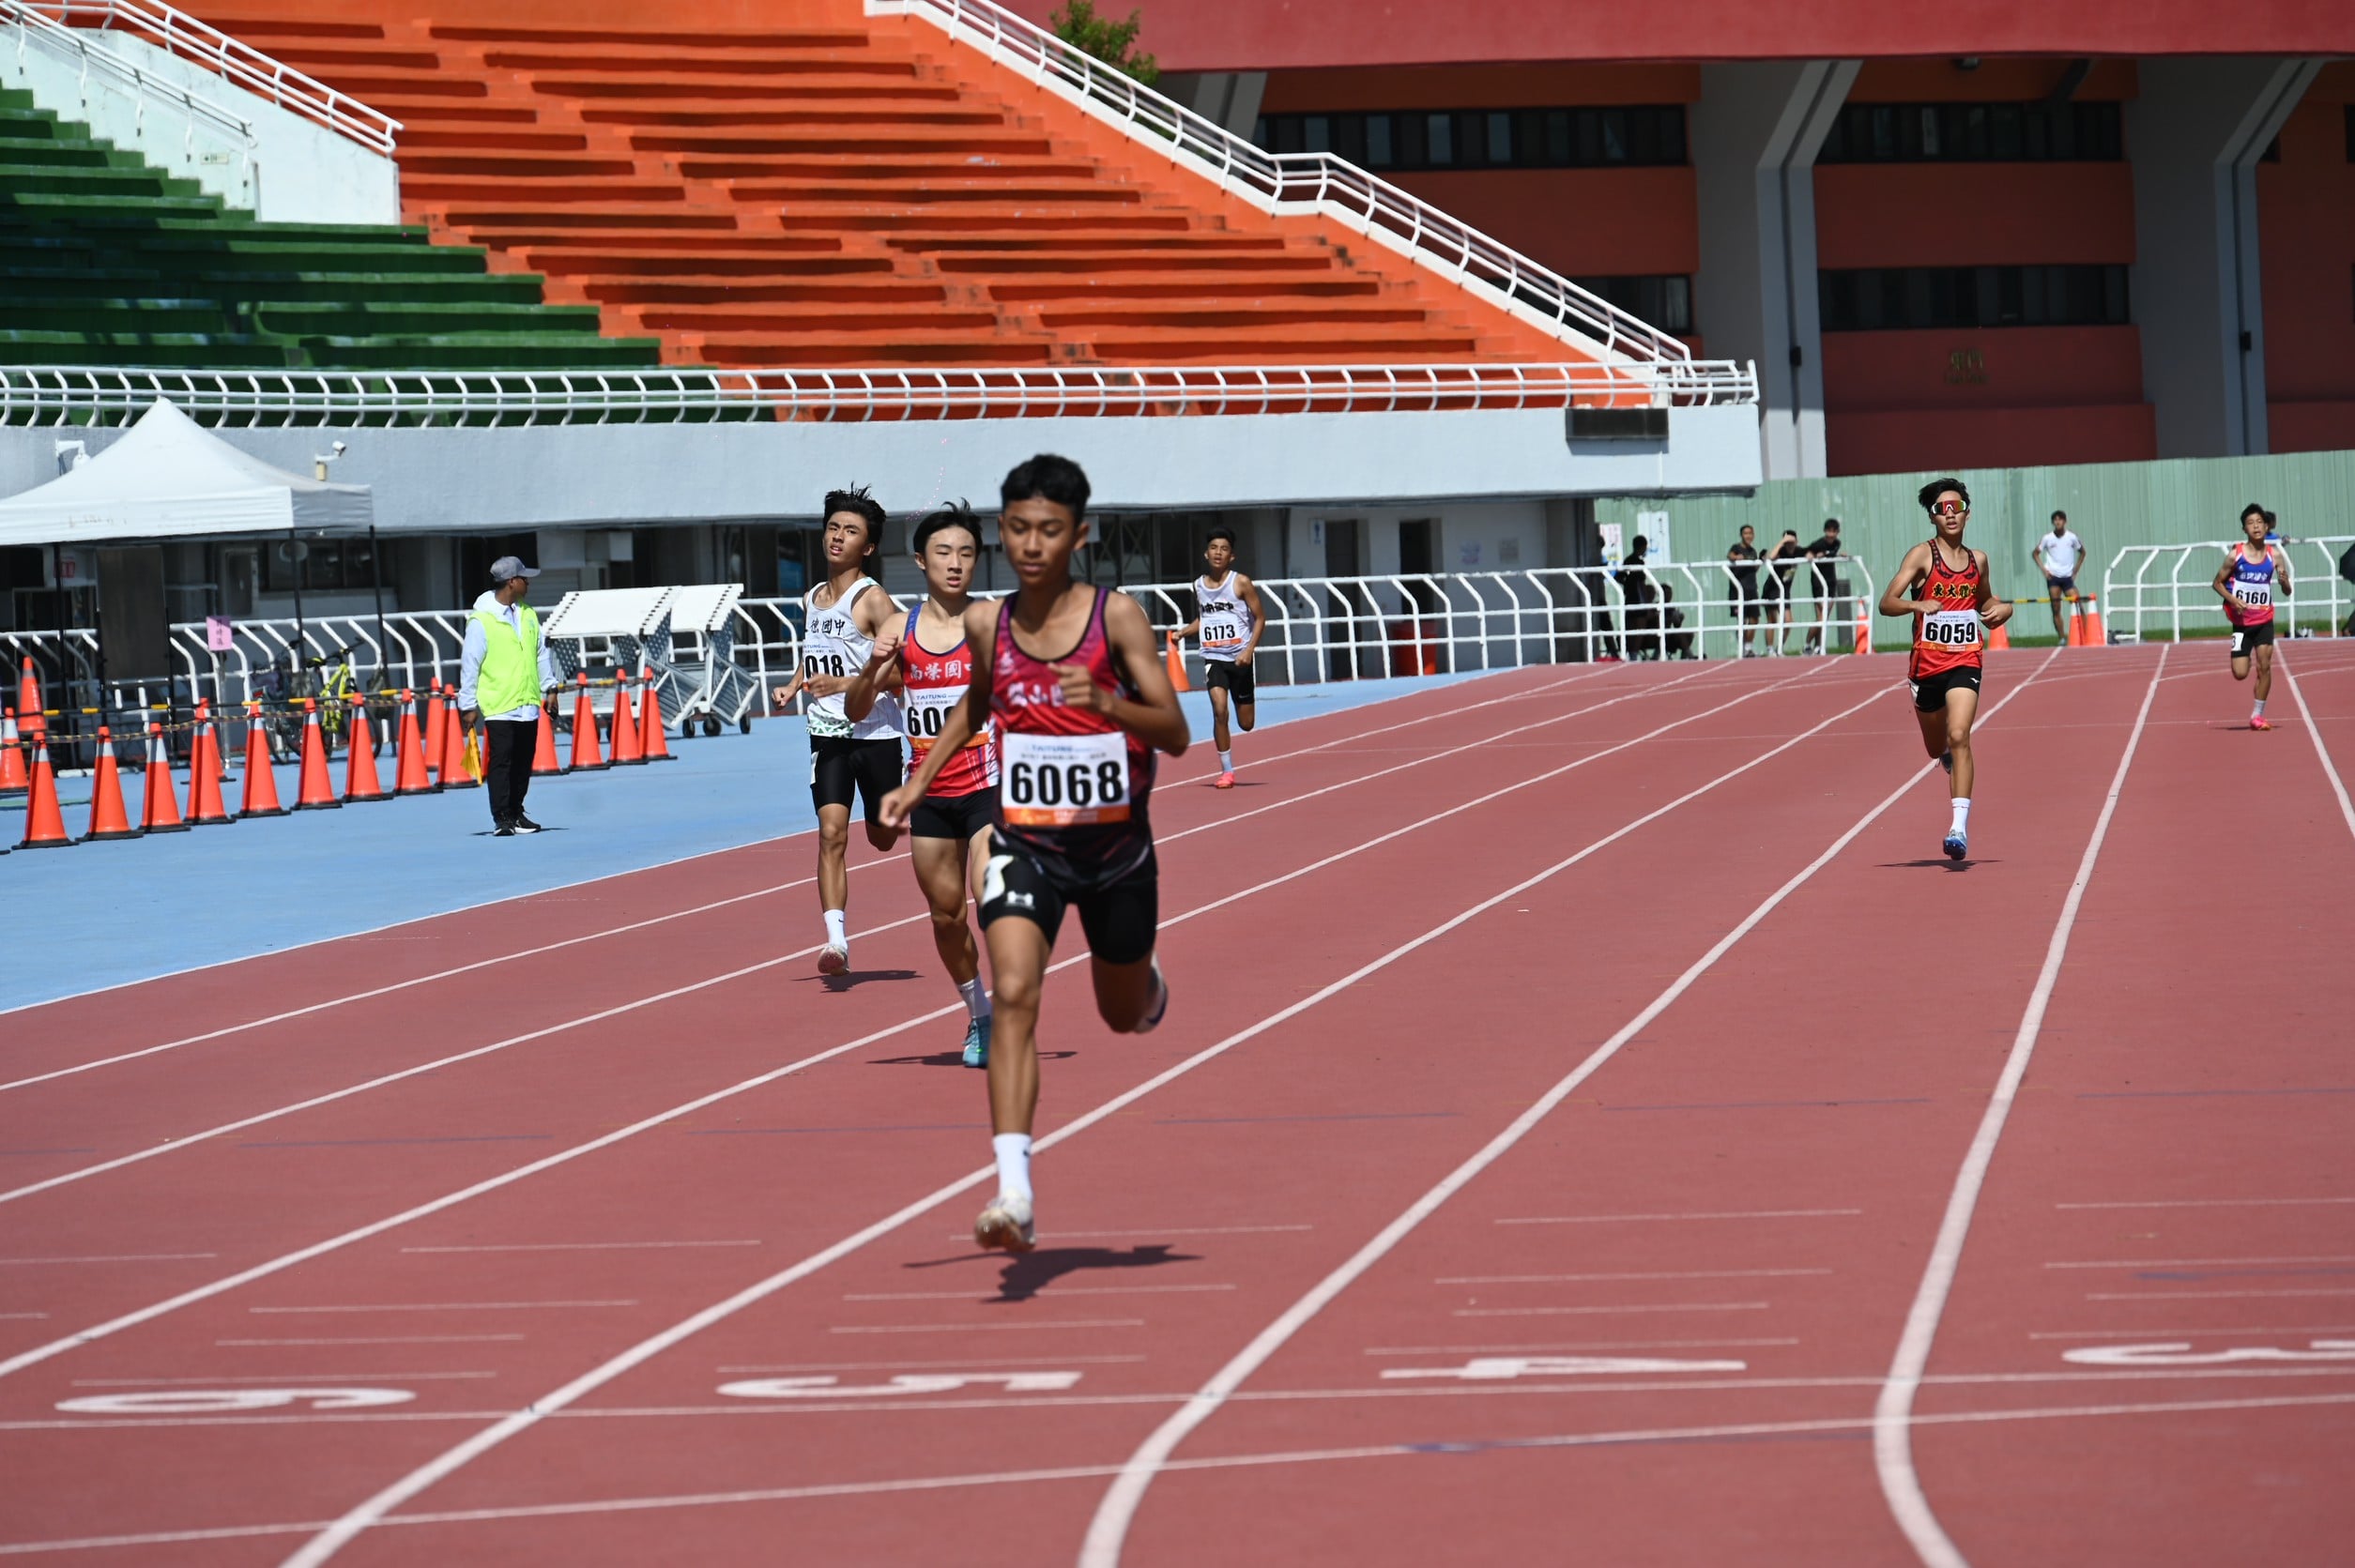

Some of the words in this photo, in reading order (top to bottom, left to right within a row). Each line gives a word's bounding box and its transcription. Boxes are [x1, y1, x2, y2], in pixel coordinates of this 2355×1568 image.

[2236, 589, 2268, 605] 6160
[804, 617, 846, 636] 德國中
[1204, 624, 1236, 641] 6173
[1925, 621, 1976, 645] 6059
[803, 654, 845, 679] 018
[907, 706, 956, 737] 60
[1011, 761, 1124, 806] 6068
[1381, 1356, 1747, 1379] 4
[716, 1371, 1081, 1399] 5
[55, 1386, 416, 1414] 6
